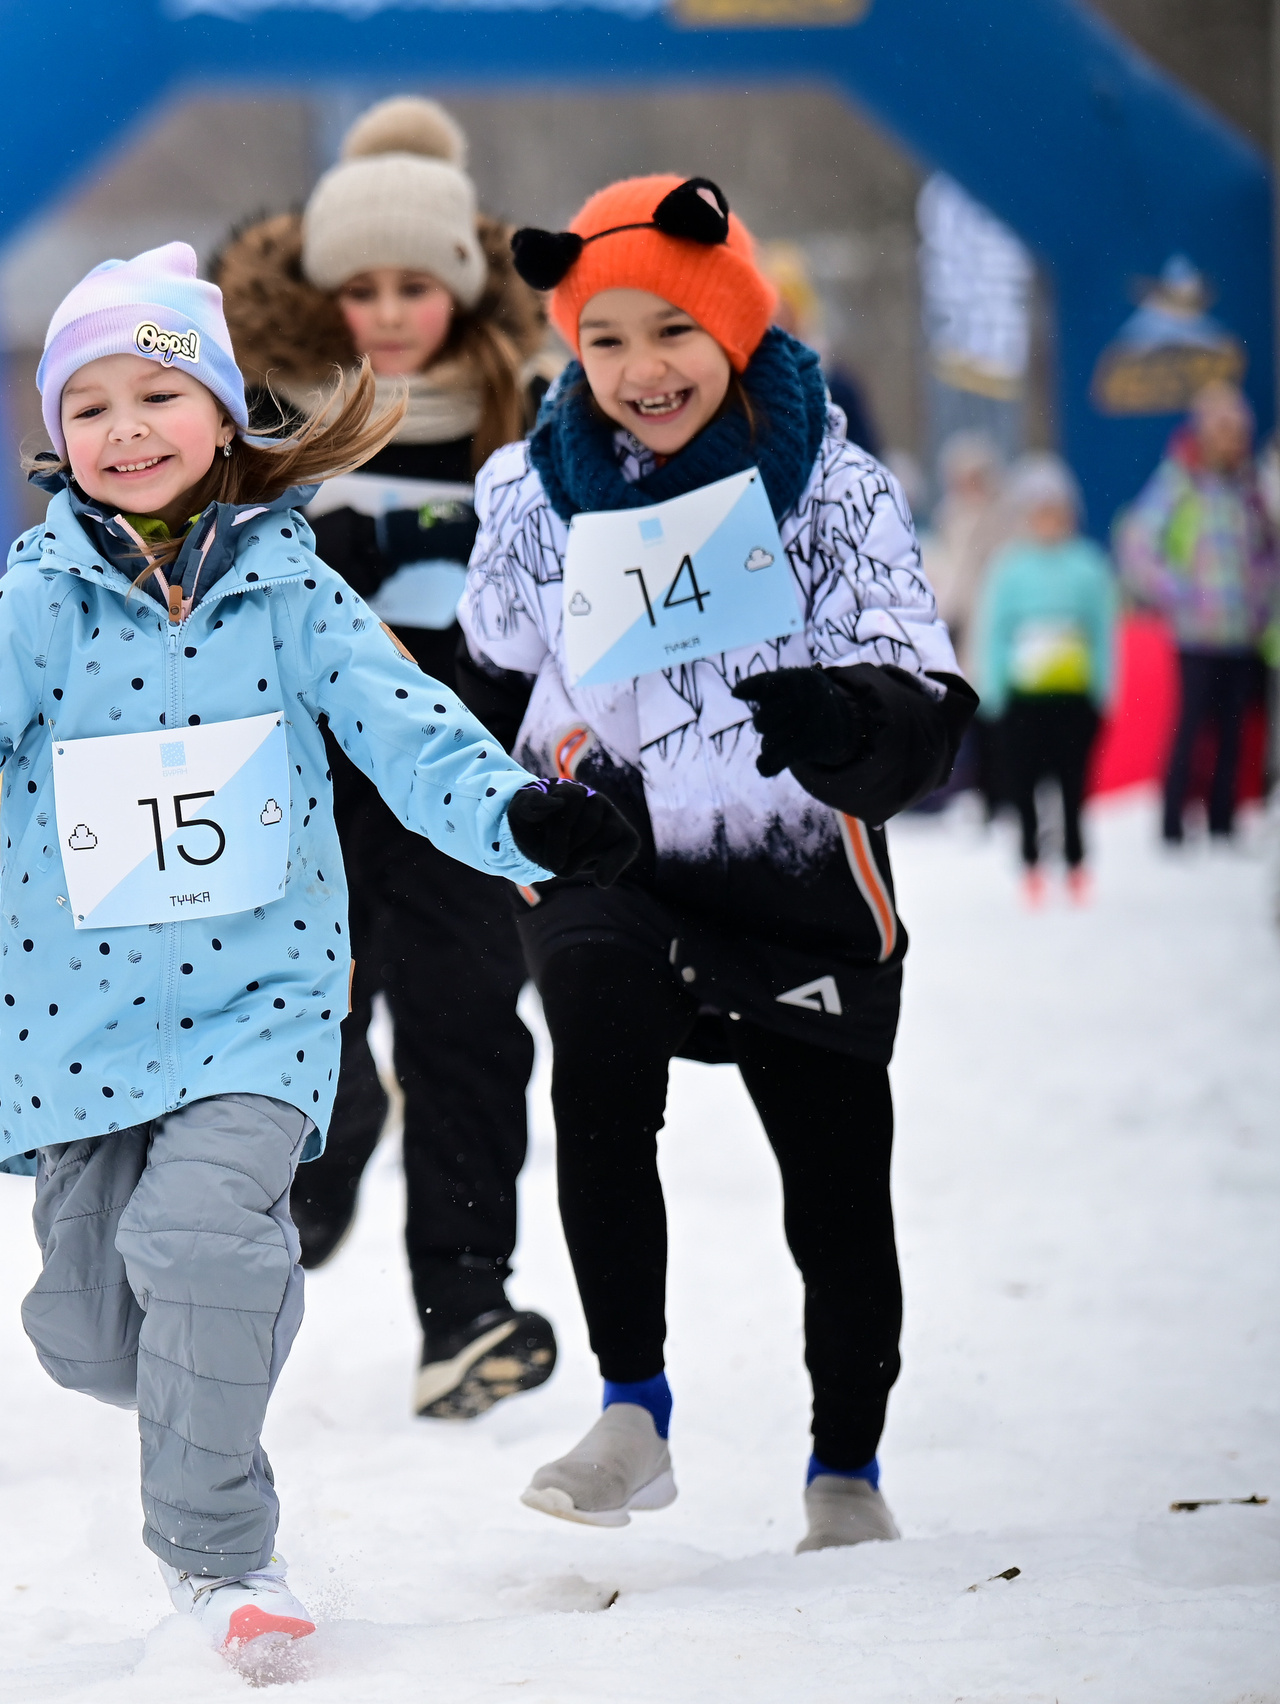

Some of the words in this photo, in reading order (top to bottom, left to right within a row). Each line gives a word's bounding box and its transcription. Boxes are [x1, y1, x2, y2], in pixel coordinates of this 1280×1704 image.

[136, 323, 198, 363] Oops!
[624, 554, 711, 627] 14
[137, 790, 226, 871] 15
[169, 891, 211, 906] ТУЧКА
